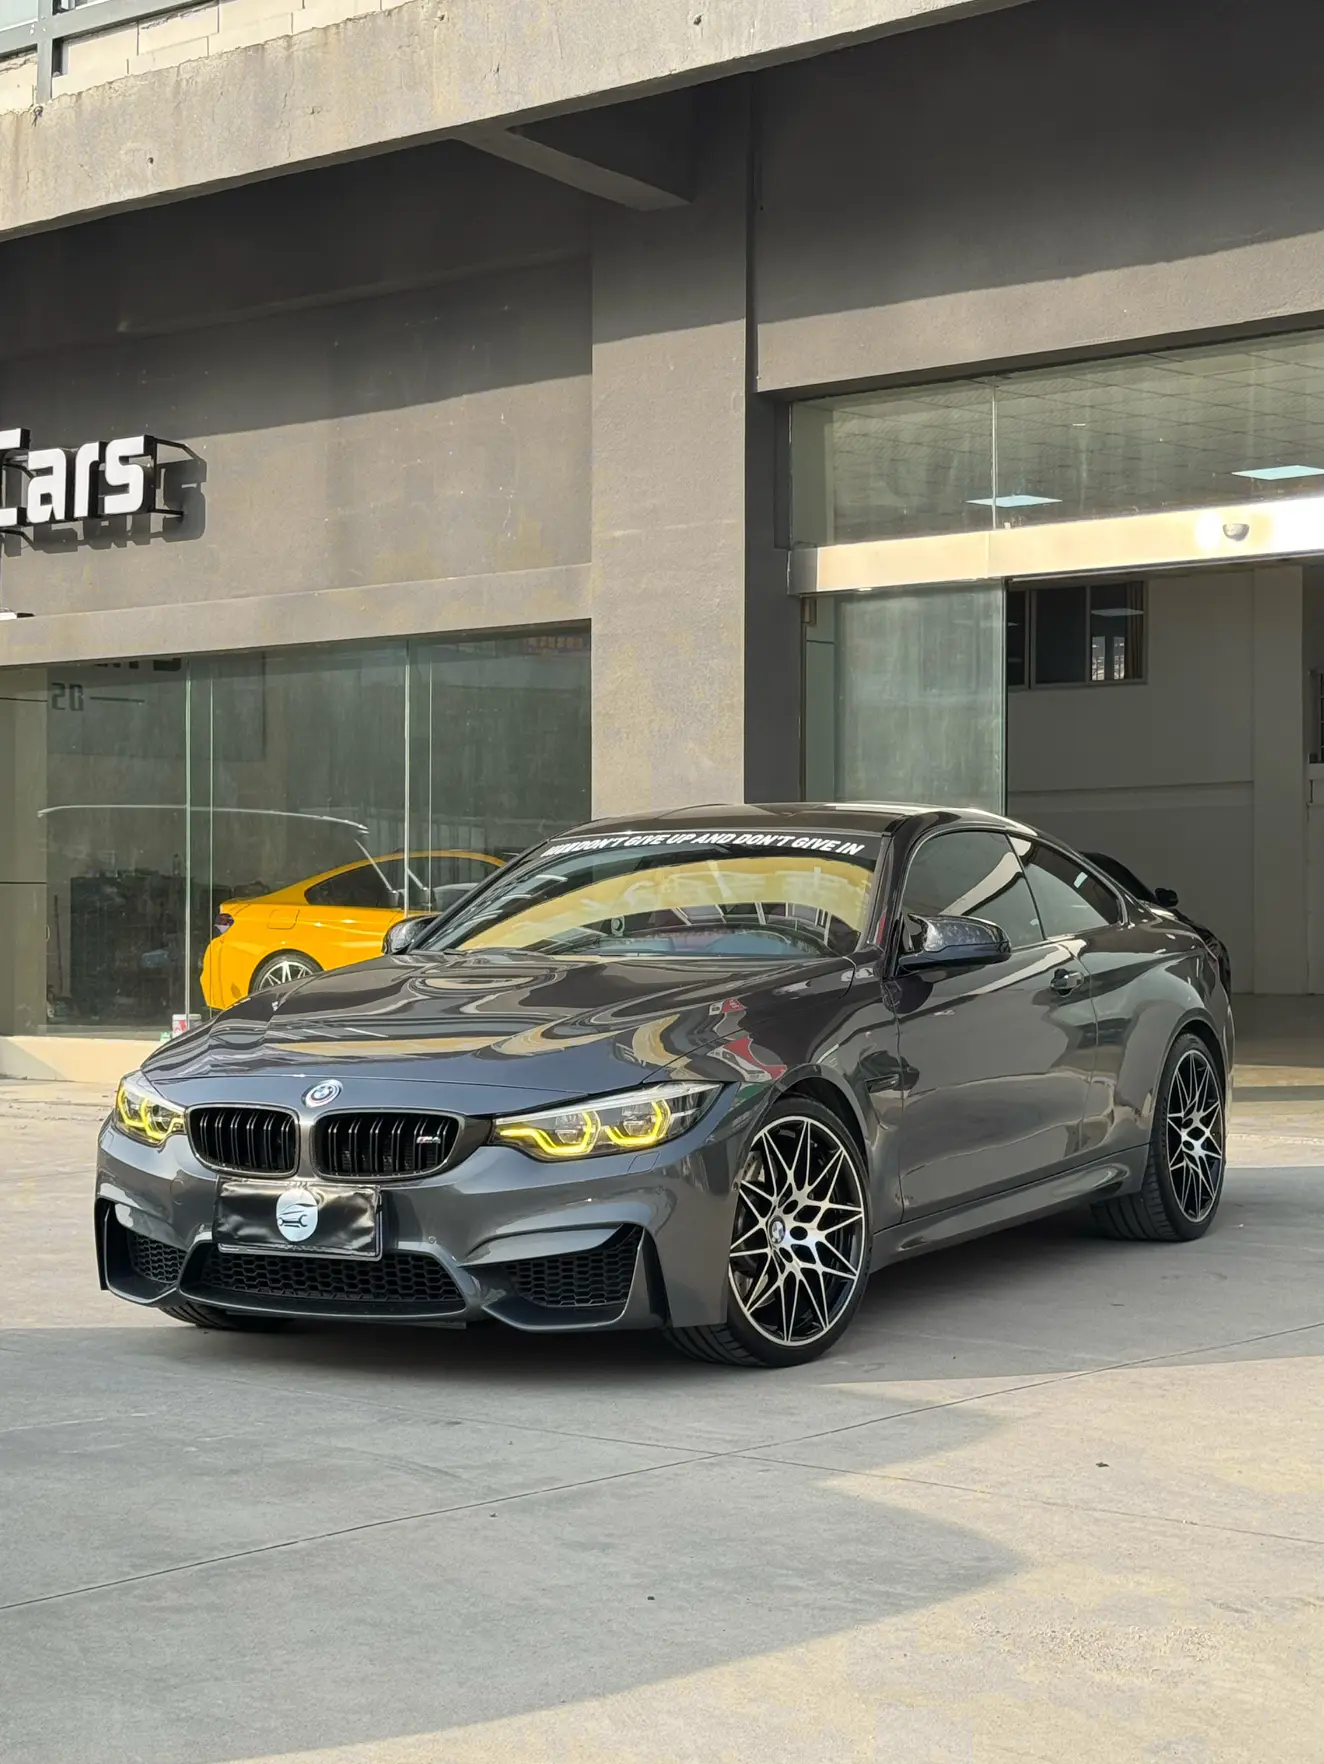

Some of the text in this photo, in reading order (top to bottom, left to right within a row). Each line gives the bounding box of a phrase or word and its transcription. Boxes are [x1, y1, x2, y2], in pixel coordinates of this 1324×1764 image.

[624, 834, 671, 847] GIVE
[666, 833, 697, 845] UP
[690, 833, 737, 844] AND
[732, 833, 796, 847] DON'T
[791, 837, 842, 852] GIVE
[835, 842, 865, 856] IN
